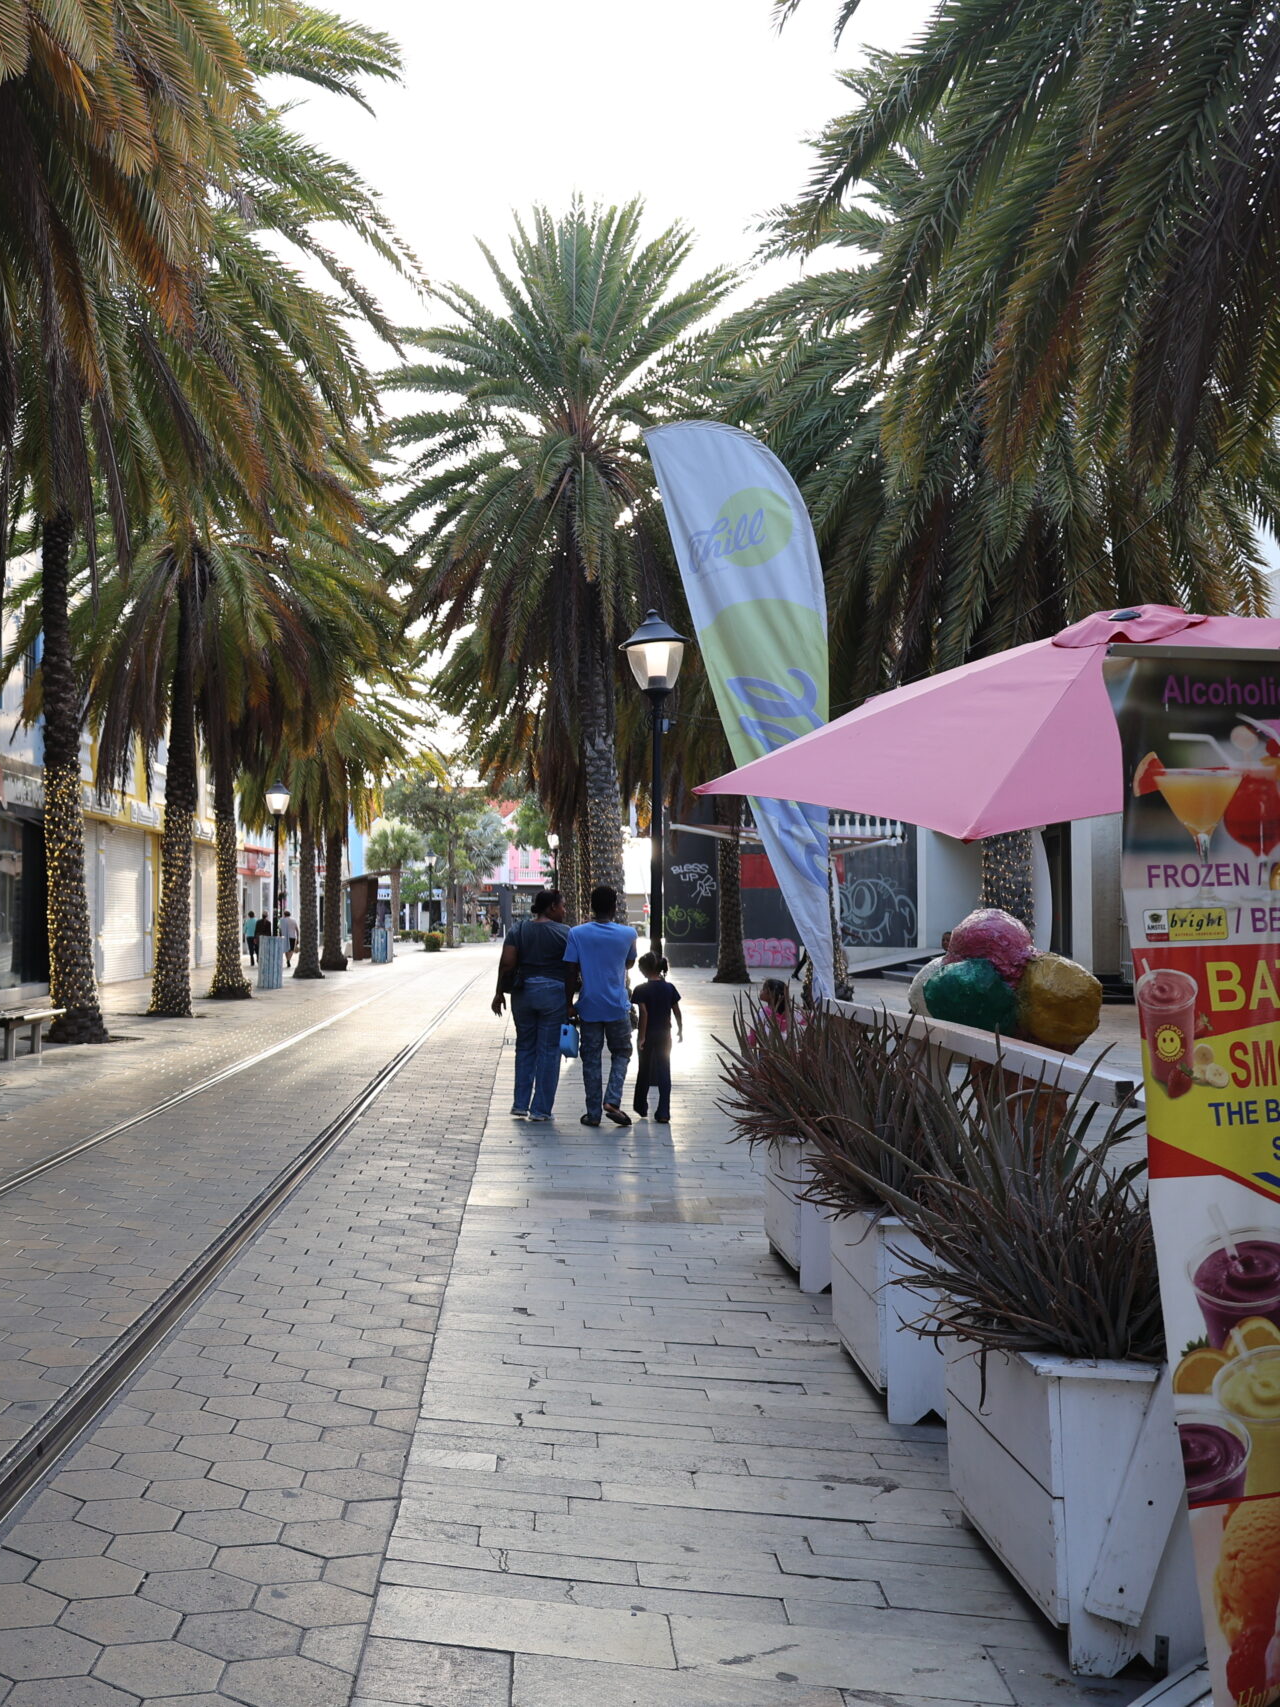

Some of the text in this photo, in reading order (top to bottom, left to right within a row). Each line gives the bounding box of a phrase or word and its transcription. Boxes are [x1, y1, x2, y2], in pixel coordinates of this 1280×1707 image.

[1163, 674, 1280, 705] Alcoholi
[680, 873, 699, 882] UP
[1147, 862, 1250, 889] FROZEN
[1170, 912, 1223, 932] bright
[1205, 959, 1280, 1011] BA
[1229, 1039, 1280, 1089] SM
[1207, 1100, 1259, 1127] THE
